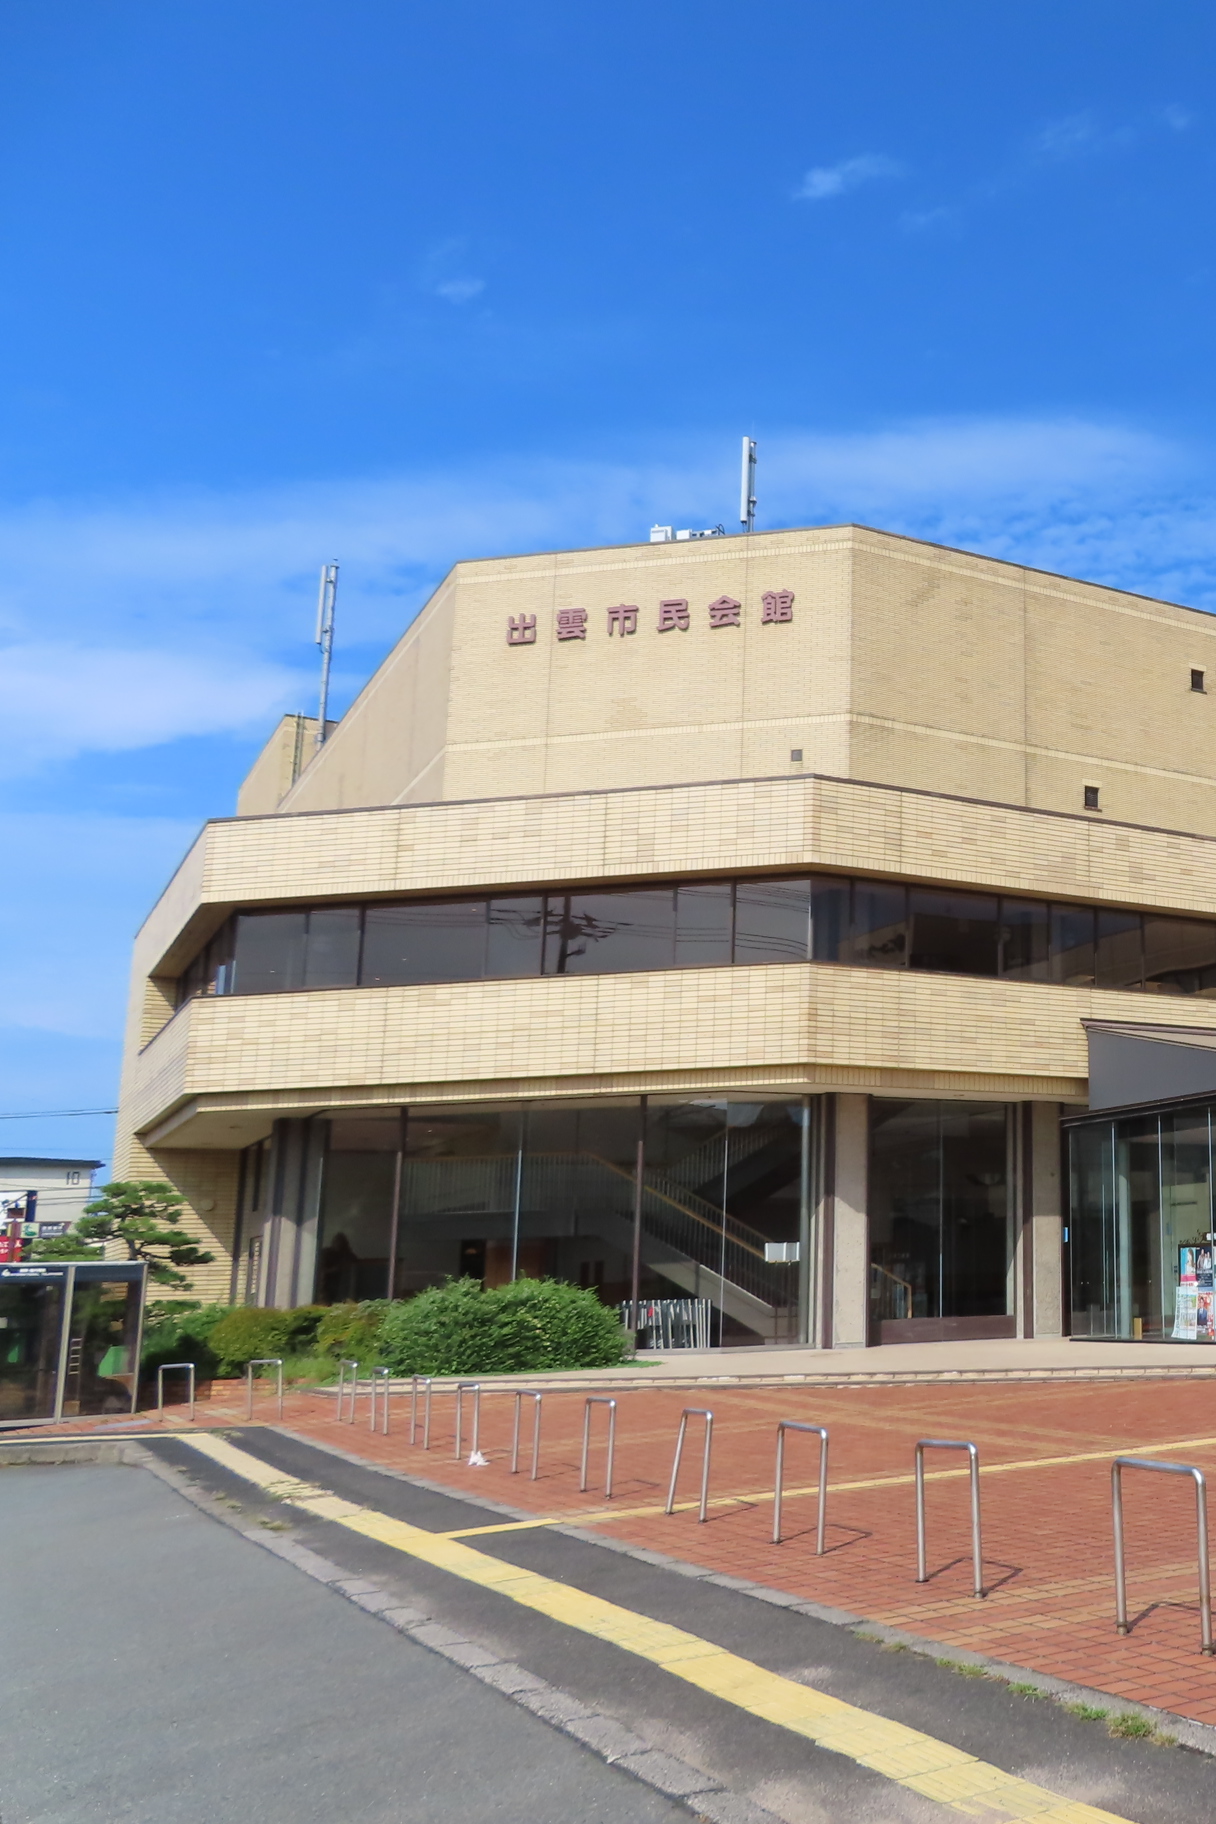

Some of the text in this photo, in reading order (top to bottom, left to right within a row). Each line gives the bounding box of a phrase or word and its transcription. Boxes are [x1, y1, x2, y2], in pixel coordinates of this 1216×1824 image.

[506, 588, 795, 645] 出雲市民会館
